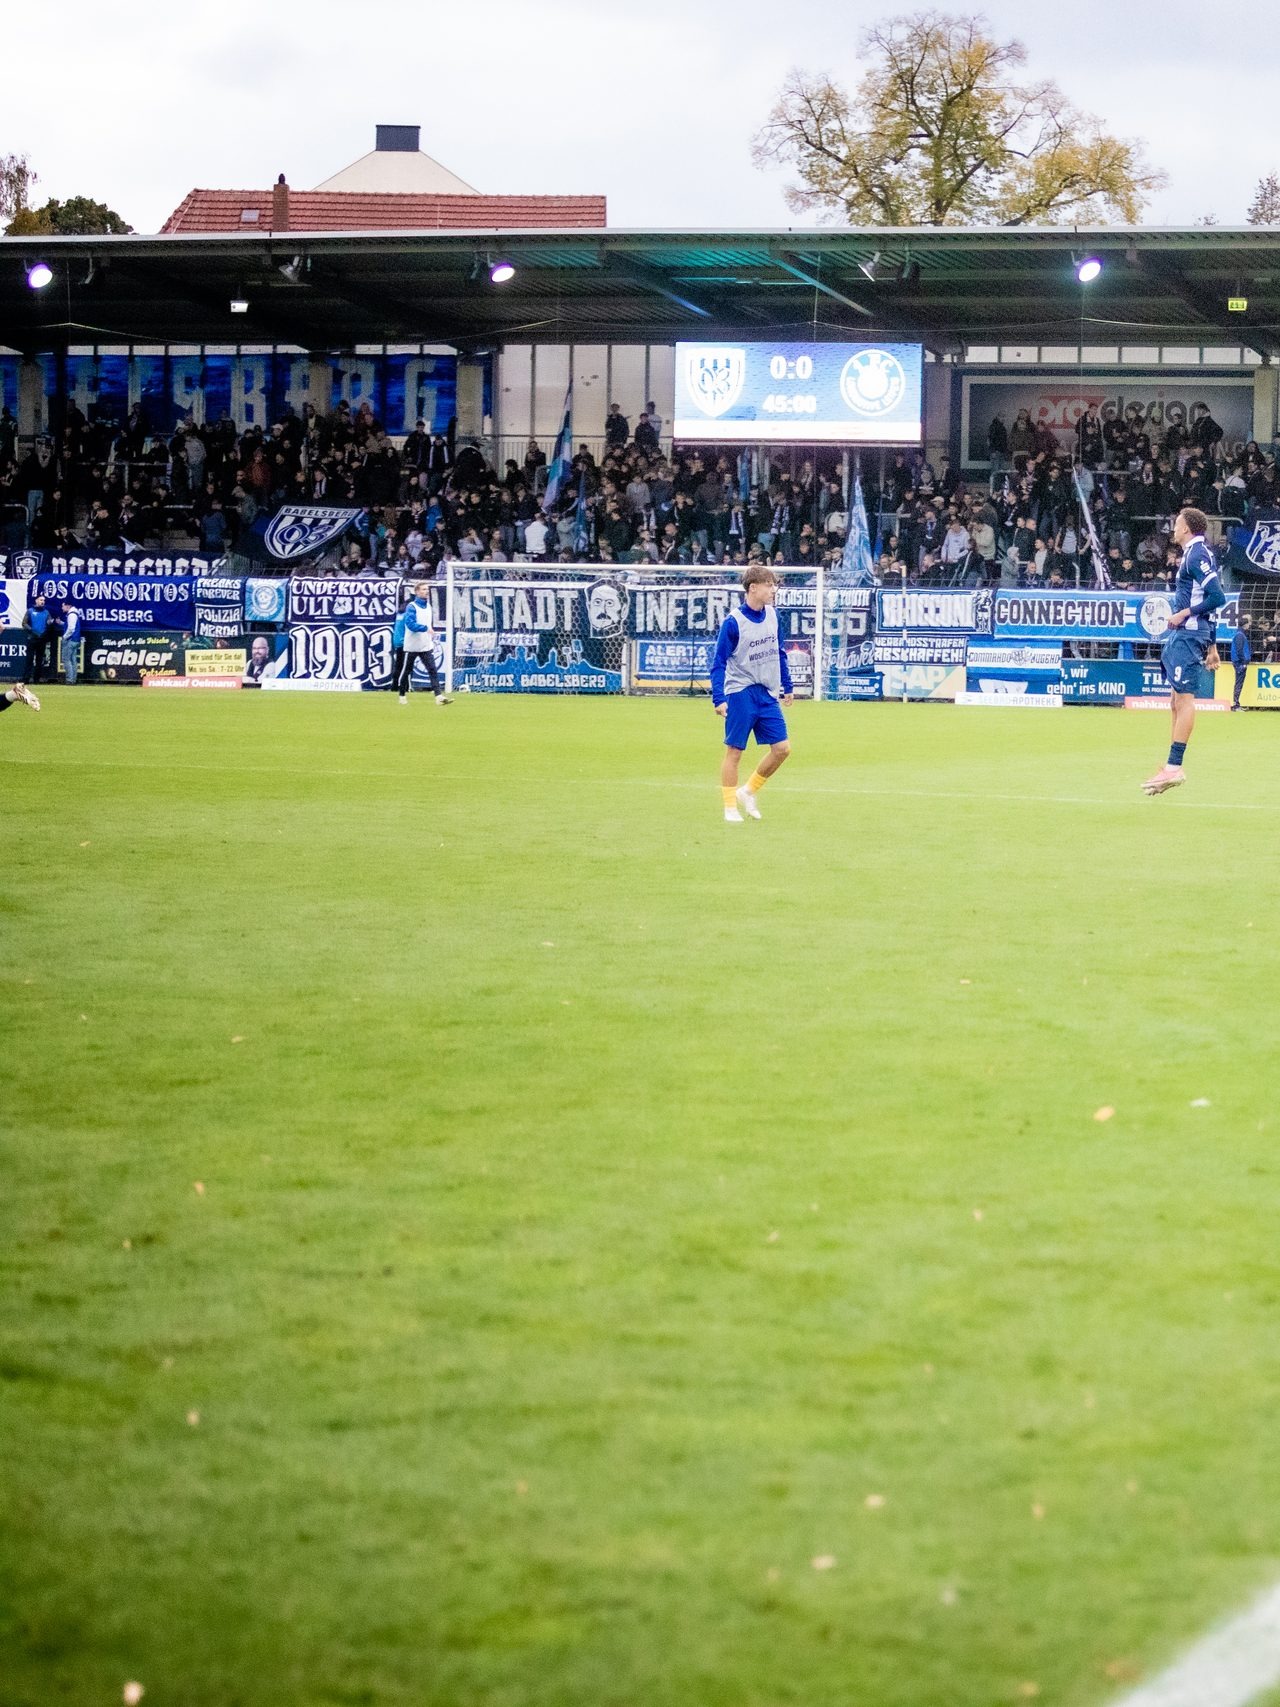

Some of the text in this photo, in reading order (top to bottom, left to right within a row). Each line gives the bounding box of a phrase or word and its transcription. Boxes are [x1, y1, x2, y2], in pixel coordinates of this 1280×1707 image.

[770, 355, 813, 379] 0:0
[31, 580, 190, 602] LOS CONSORTOS
[196, 578, 241, 589] FREAKS
[293, 580, 397, 596] UNDERDOGS
[196, 588, 241, 600] FOREVER
[79, 608, 153, 623] ABELSBERG
[198, 606, 241, 622] POLIZIA
[404, 586, 578, 631] LMSTADT
[996, 600, 1126, 627] CONNECTION
[91, 649, 173, 667] Gabler
[290, 625, 395, 686] 1903
[645, 645, 708, 656] ALERTA
[645, 656, 708, 666] NETWORK
[1071, 665, 1088, 678] wir
[1173, 666, 1182, 682] 9
[191, 678, 237, 688] Oelmann
[465, 674, 514, 688] ULTRAS
[1079, 682, 1096, 695] ins
[1098, 682, 1126, 696] KINO
[1131, 699, 1171, 710] nahkau
